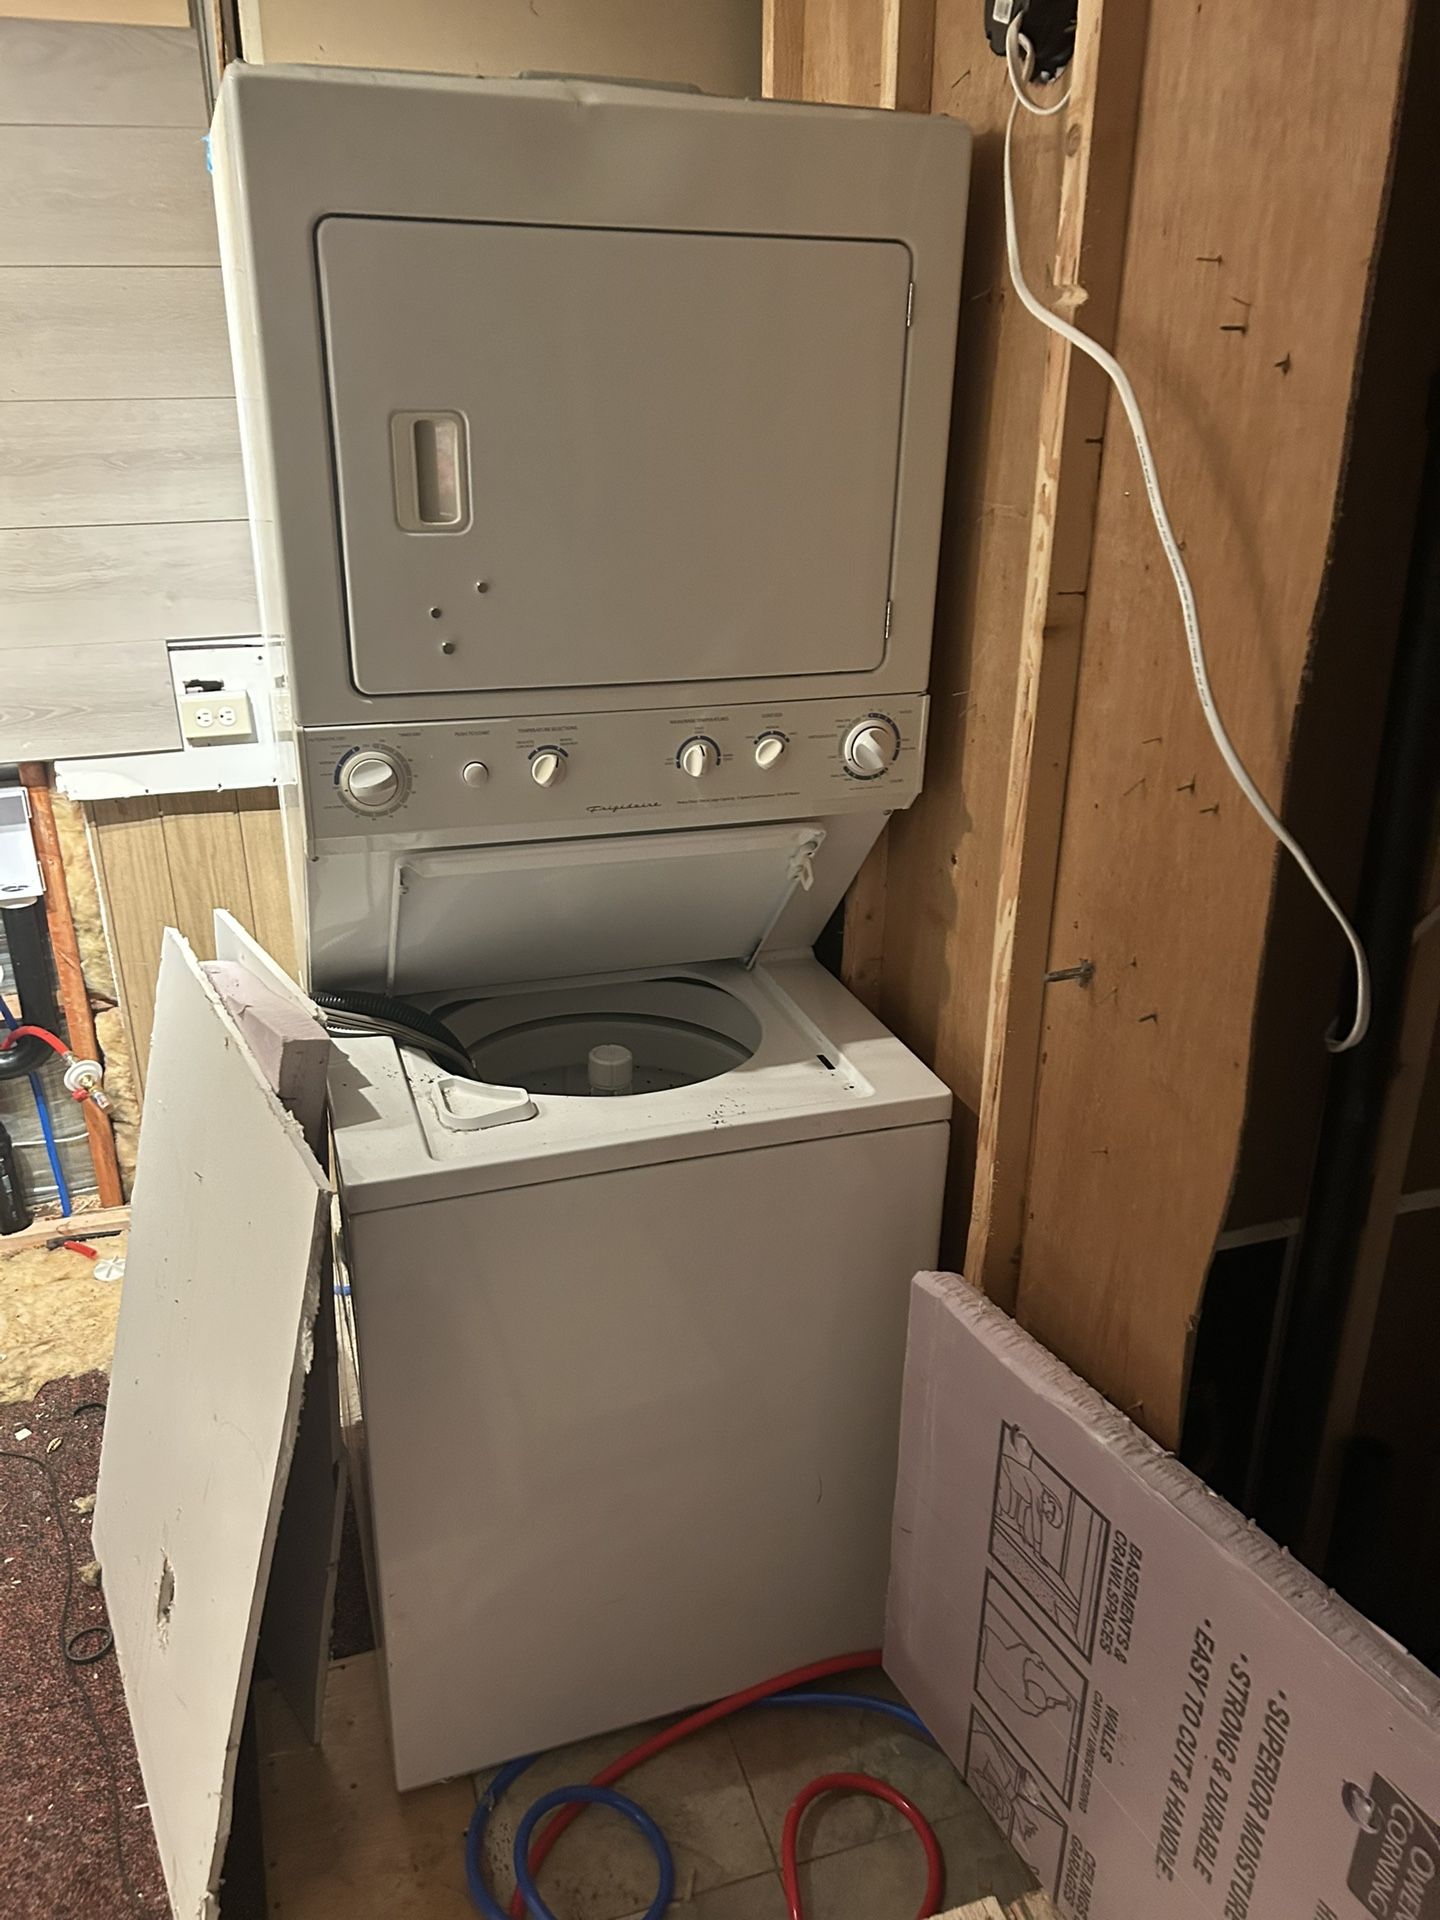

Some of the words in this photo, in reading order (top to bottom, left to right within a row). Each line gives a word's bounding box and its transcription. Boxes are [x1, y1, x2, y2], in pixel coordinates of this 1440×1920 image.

[586, 802, 662, 813] Frigidaire
[1116, 1541, 1143, 1651] BASEMENTS
[1114, 1648, 1128, 1664] &
[1188, 1626, 1215, 1697] EASY
[1089, 1690, 1104, 1732] CAVITY
[1100, 1704, 1120, 1765] WALLS
[1182, 1692, 1204, 1729] TO
[1215, 1663, 1252, 1764] STRONG
[1170, 1771, 1188, 1793] &
[1174, 1724, 1198, 1779] CUT
[1212, 1759, 1232, 1782] &
[1248, 1699, 1291, 1820] SUPERIOR
[1192, 1777, 1229, 1885] DURABLE
[1367, 1803, 1415, 1917] CORNING
[1063, 1835, 1083, 1908] GARAGES
[1074, 1850, 1097, 1919] CEILINGS
